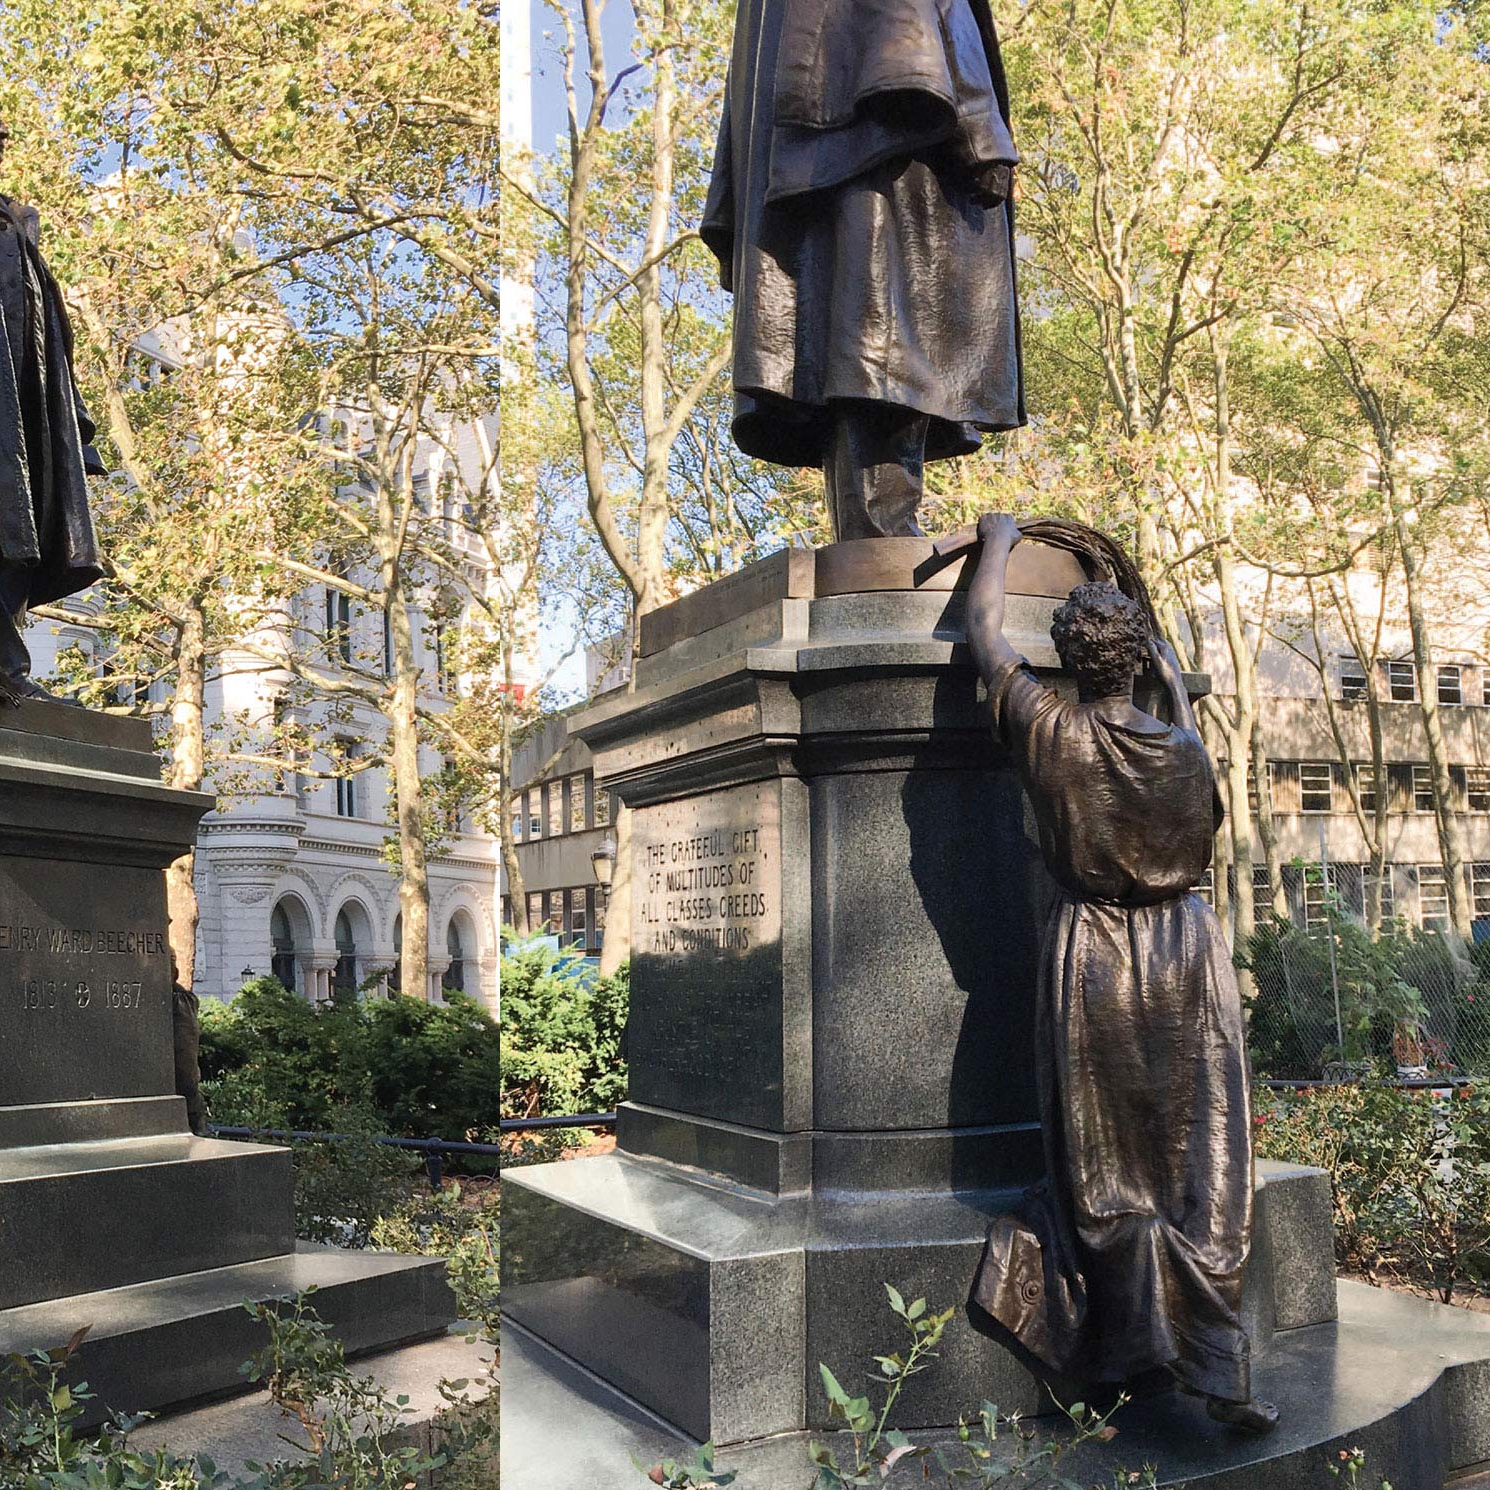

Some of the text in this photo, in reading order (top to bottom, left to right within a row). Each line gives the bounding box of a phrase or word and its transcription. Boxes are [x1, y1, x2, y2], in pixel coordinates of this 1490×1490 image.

[646, 829, 758, 866] THE GRATEFUL GIFT
[648, 861, 755, 894] OF MULTITUDES OF
[641, 903, 659, 924] ALL
[666, 897, 712, 922] CLASSES
[46, 927, 93, 953] WARD
[96, 930, 165, 955] BEECHER
[654, 927, 749, 953] AND CONDITIONS
[22, 980, 142, 1009] 1813 1887
